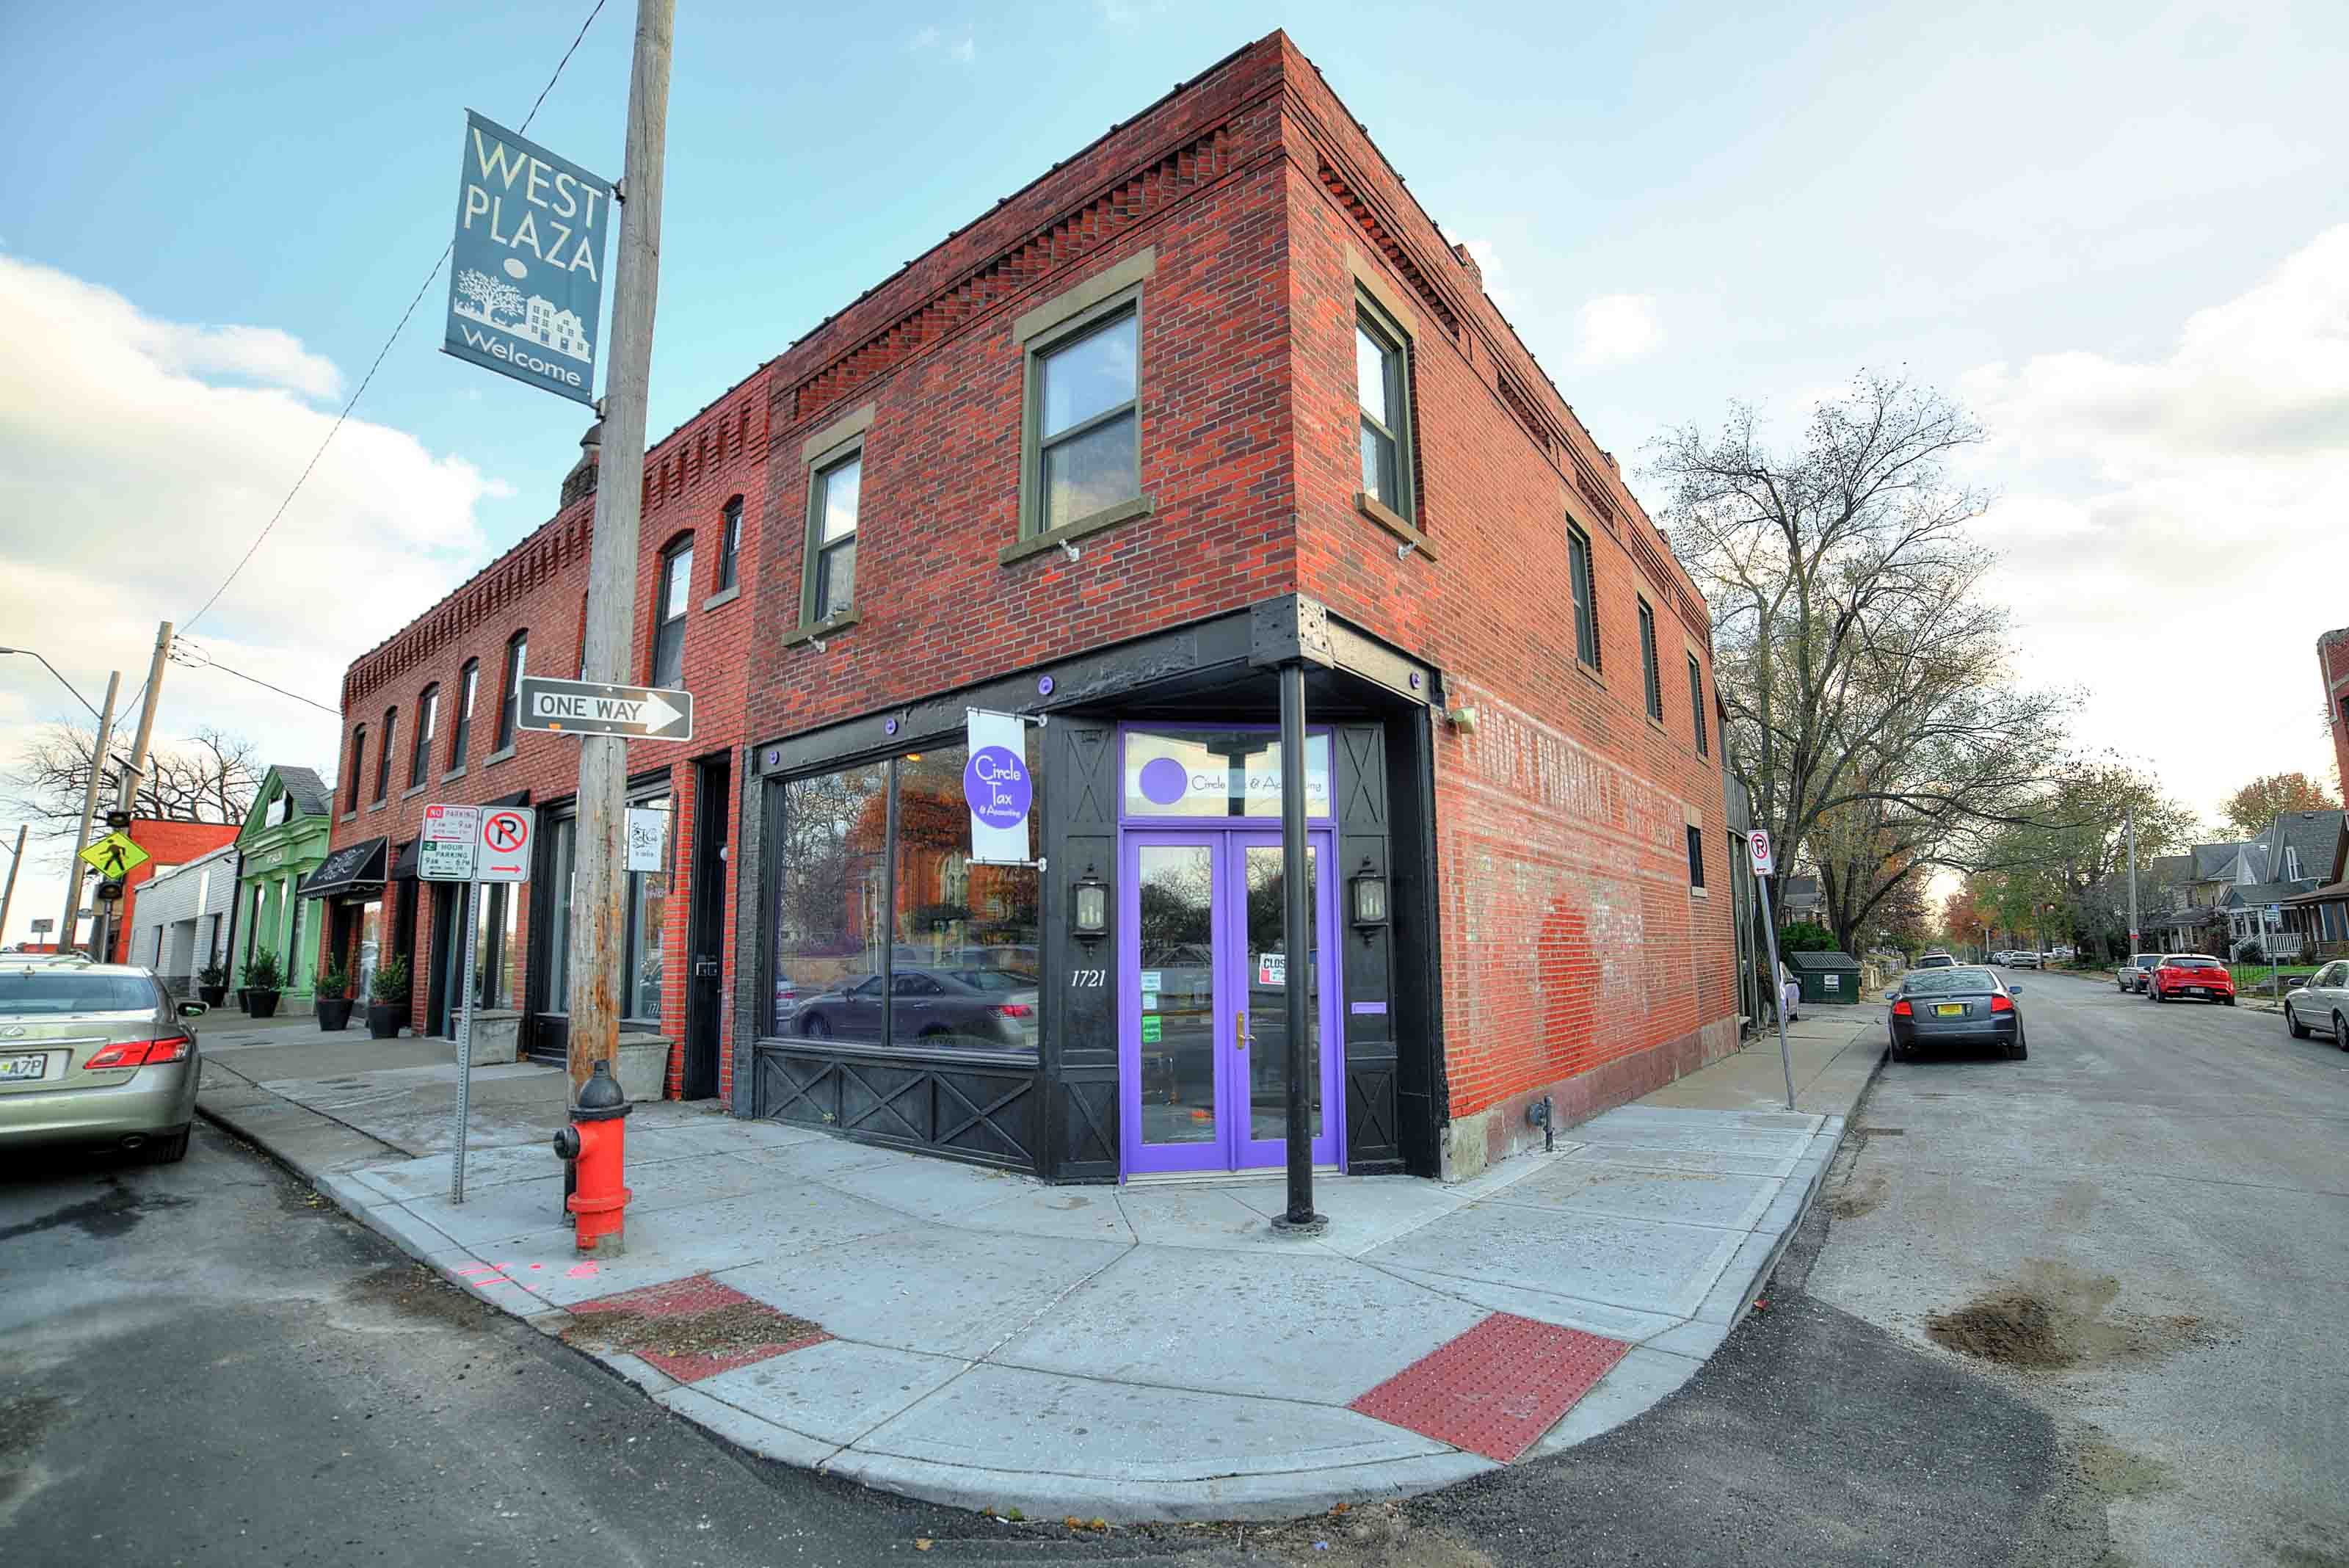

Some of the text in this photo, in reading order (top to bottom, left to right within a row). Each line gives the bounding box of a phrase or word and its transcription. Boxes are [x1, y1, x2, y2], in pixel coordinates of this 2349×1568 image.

[473, 128, 603, 230] WEST
[463, 184, 598, 283] PLAZA
[461, 324, 581, 387] Welcome
[540, 694, 642, 722] ONE WAY
[975, 755, 1022, 781] Circle
[987, 781, 1012, 806] Tax
[1192, 774, 1226, 791] Circle
[1250, 778, 1260, 789] &
[1071, 970, 1105, 987] 1721
[9, 1060, 42, 1075] A7P
